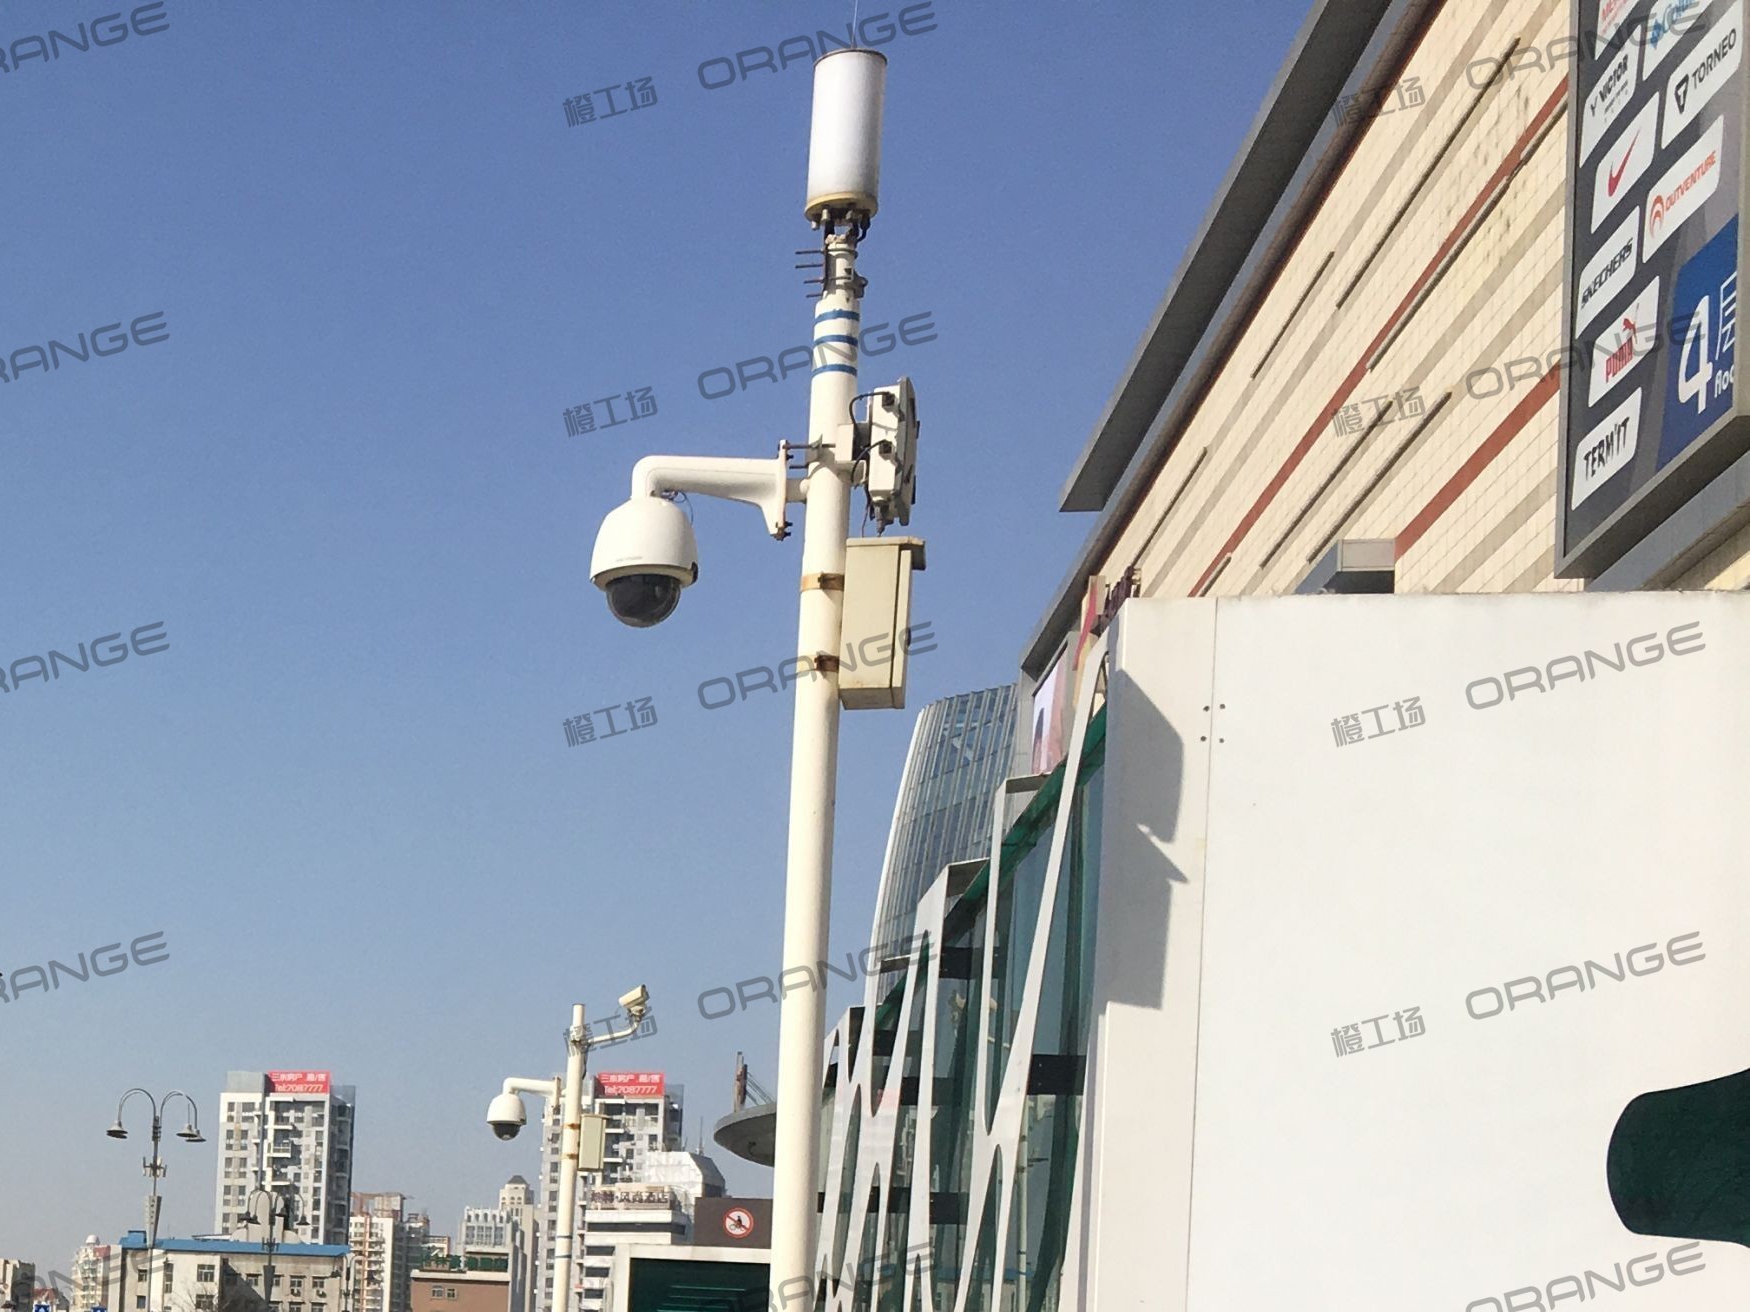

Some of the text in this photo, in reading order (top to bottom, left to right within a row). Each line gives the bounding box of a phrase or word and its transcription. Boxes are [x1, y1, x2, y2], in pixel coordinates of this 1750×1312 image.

[1599, 54, 1629, 102] VICTOR
[1691, 27, 1737, 90] TORNEO
[1665, 150, 1717, 211] OUTVENTURE
[1581, 238, 1633, 309] SKECHERS
[1605, 337, 1634, 384] PUMA
